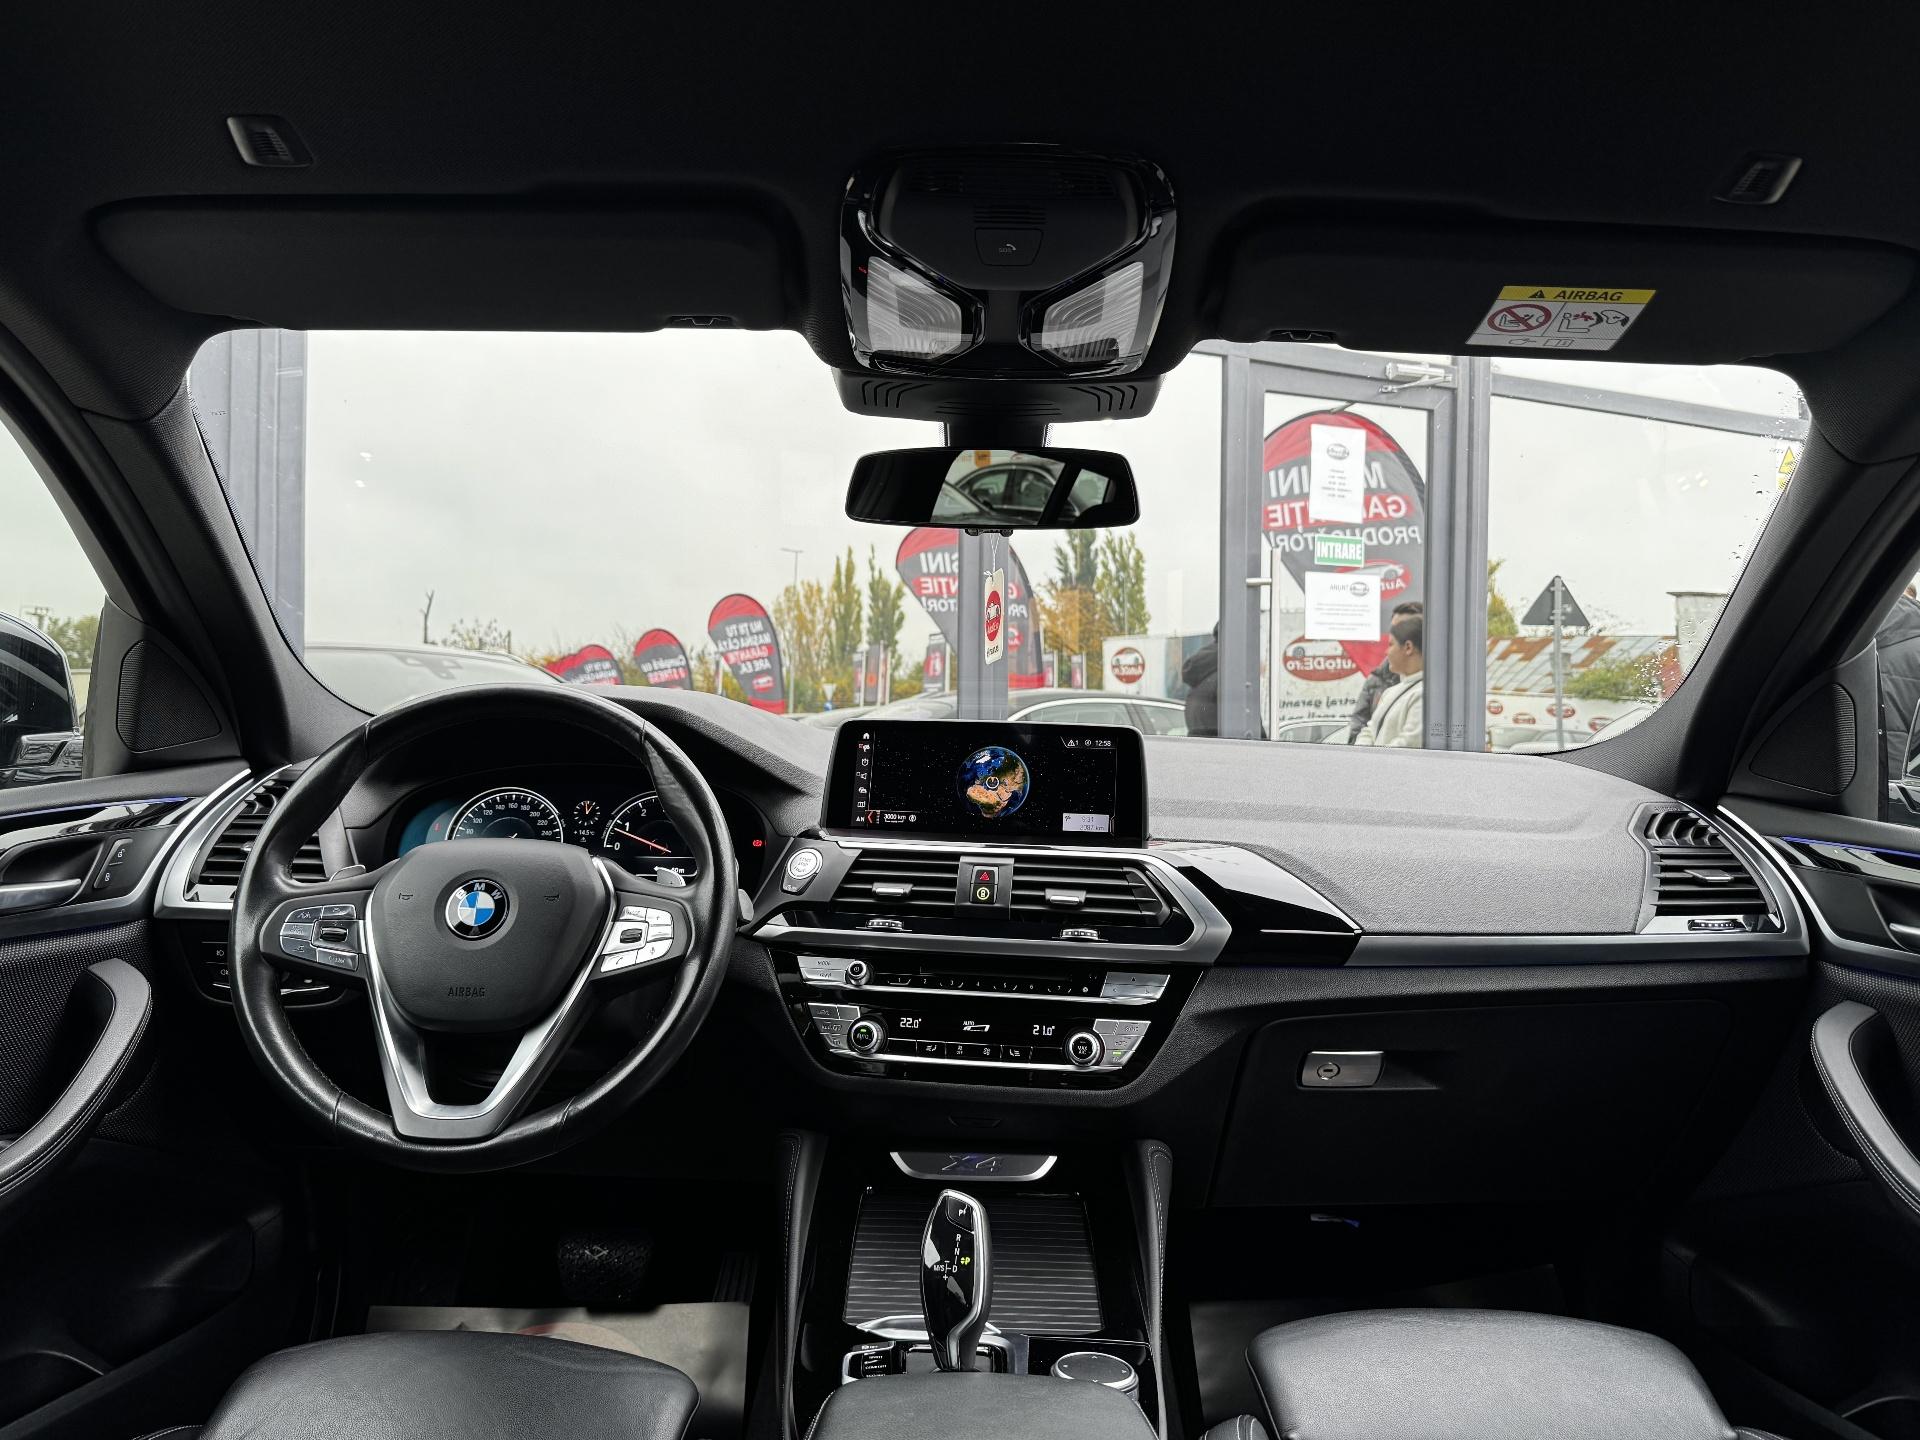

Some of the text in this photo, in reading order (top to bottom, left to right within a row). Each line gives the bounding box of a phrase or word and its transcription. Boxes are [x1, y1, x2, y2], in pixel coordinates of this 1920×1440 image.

[1554, 291, 1624, 302] AIRBAG
[1316, 541, 1363, 560] INTRARE
[641, 809, 647, 817] 2
[614, 842, 620, 851] 0
[456, 882, 503, 901] BMW
[447, 986, 486, 997] AIRBAG
[956, 1233, 962, 1242] R
[954, 1247, 960, 1256] N
[952, 1265, 958, 1273] D
